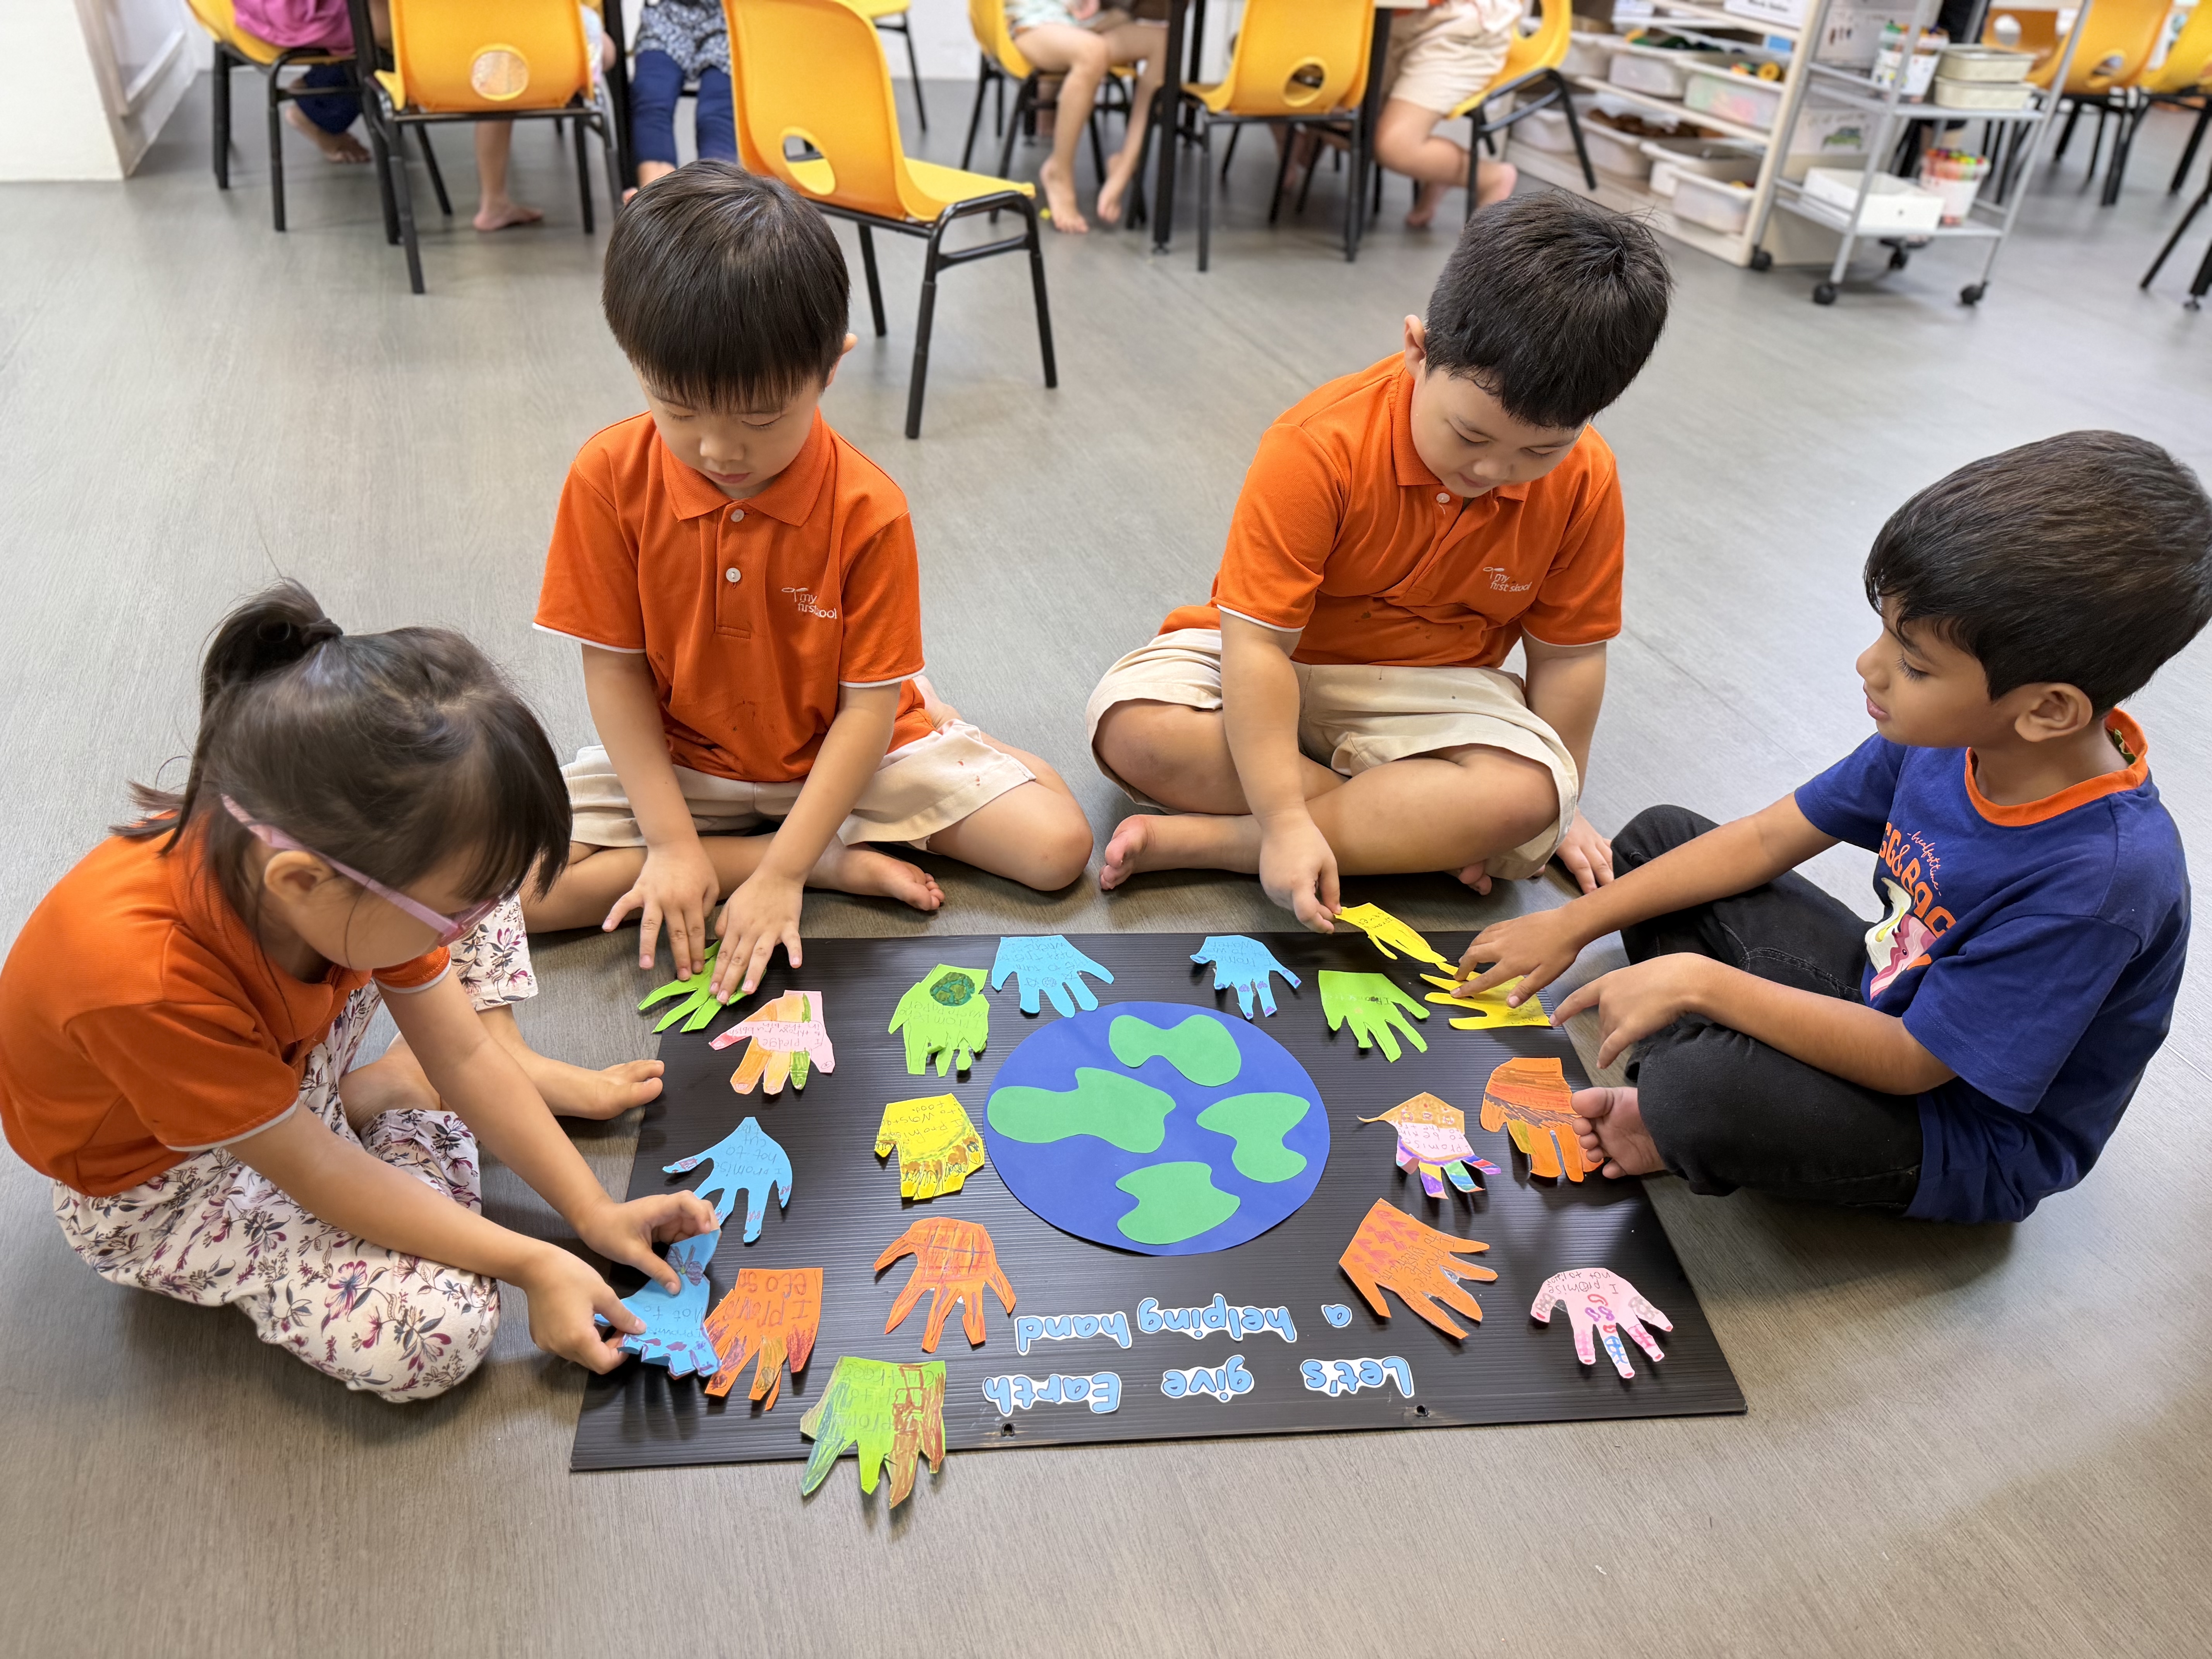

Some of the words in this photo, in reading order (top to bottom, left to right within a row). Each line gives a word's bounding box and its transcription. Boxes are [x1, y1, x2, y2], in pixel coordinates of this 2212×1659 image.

[1495, 574, 1510, 583] my
[1490, 581, 1509, 592] first
[1509, 582, 1532, 592] skool
[800, 594, 817, 604] my
[1263, 958, 1274, 966] I
[730, 1027, 771, 1036] rubbish
[763, 1038, 799, 1049] pledge
[743, 1134, 766, 1148] cut
[1423, 1132, 1440, 1140] be
[1405, 1138, 1462, 1152] promise
[726, 1146, 750, 1159] to
[753, 1149, 777, 1164] not
[1548, 1279, 1600, 1295] promise
[1609, 1284, 1618, 1294] I
[643, 1305, 663, 1318] to
[791, 1300, 812, 1319] I
[1324, 1305, 1351, 1326] a
[1139, 1295, 1296, 1341] helping
[1017, 1313, 1131, 1354] hand
[1163, 1357, 1252, 1401] give
[1304, 1358, 1413, 1396] Let's
[984, 1374, 1121, 1414] Earth
